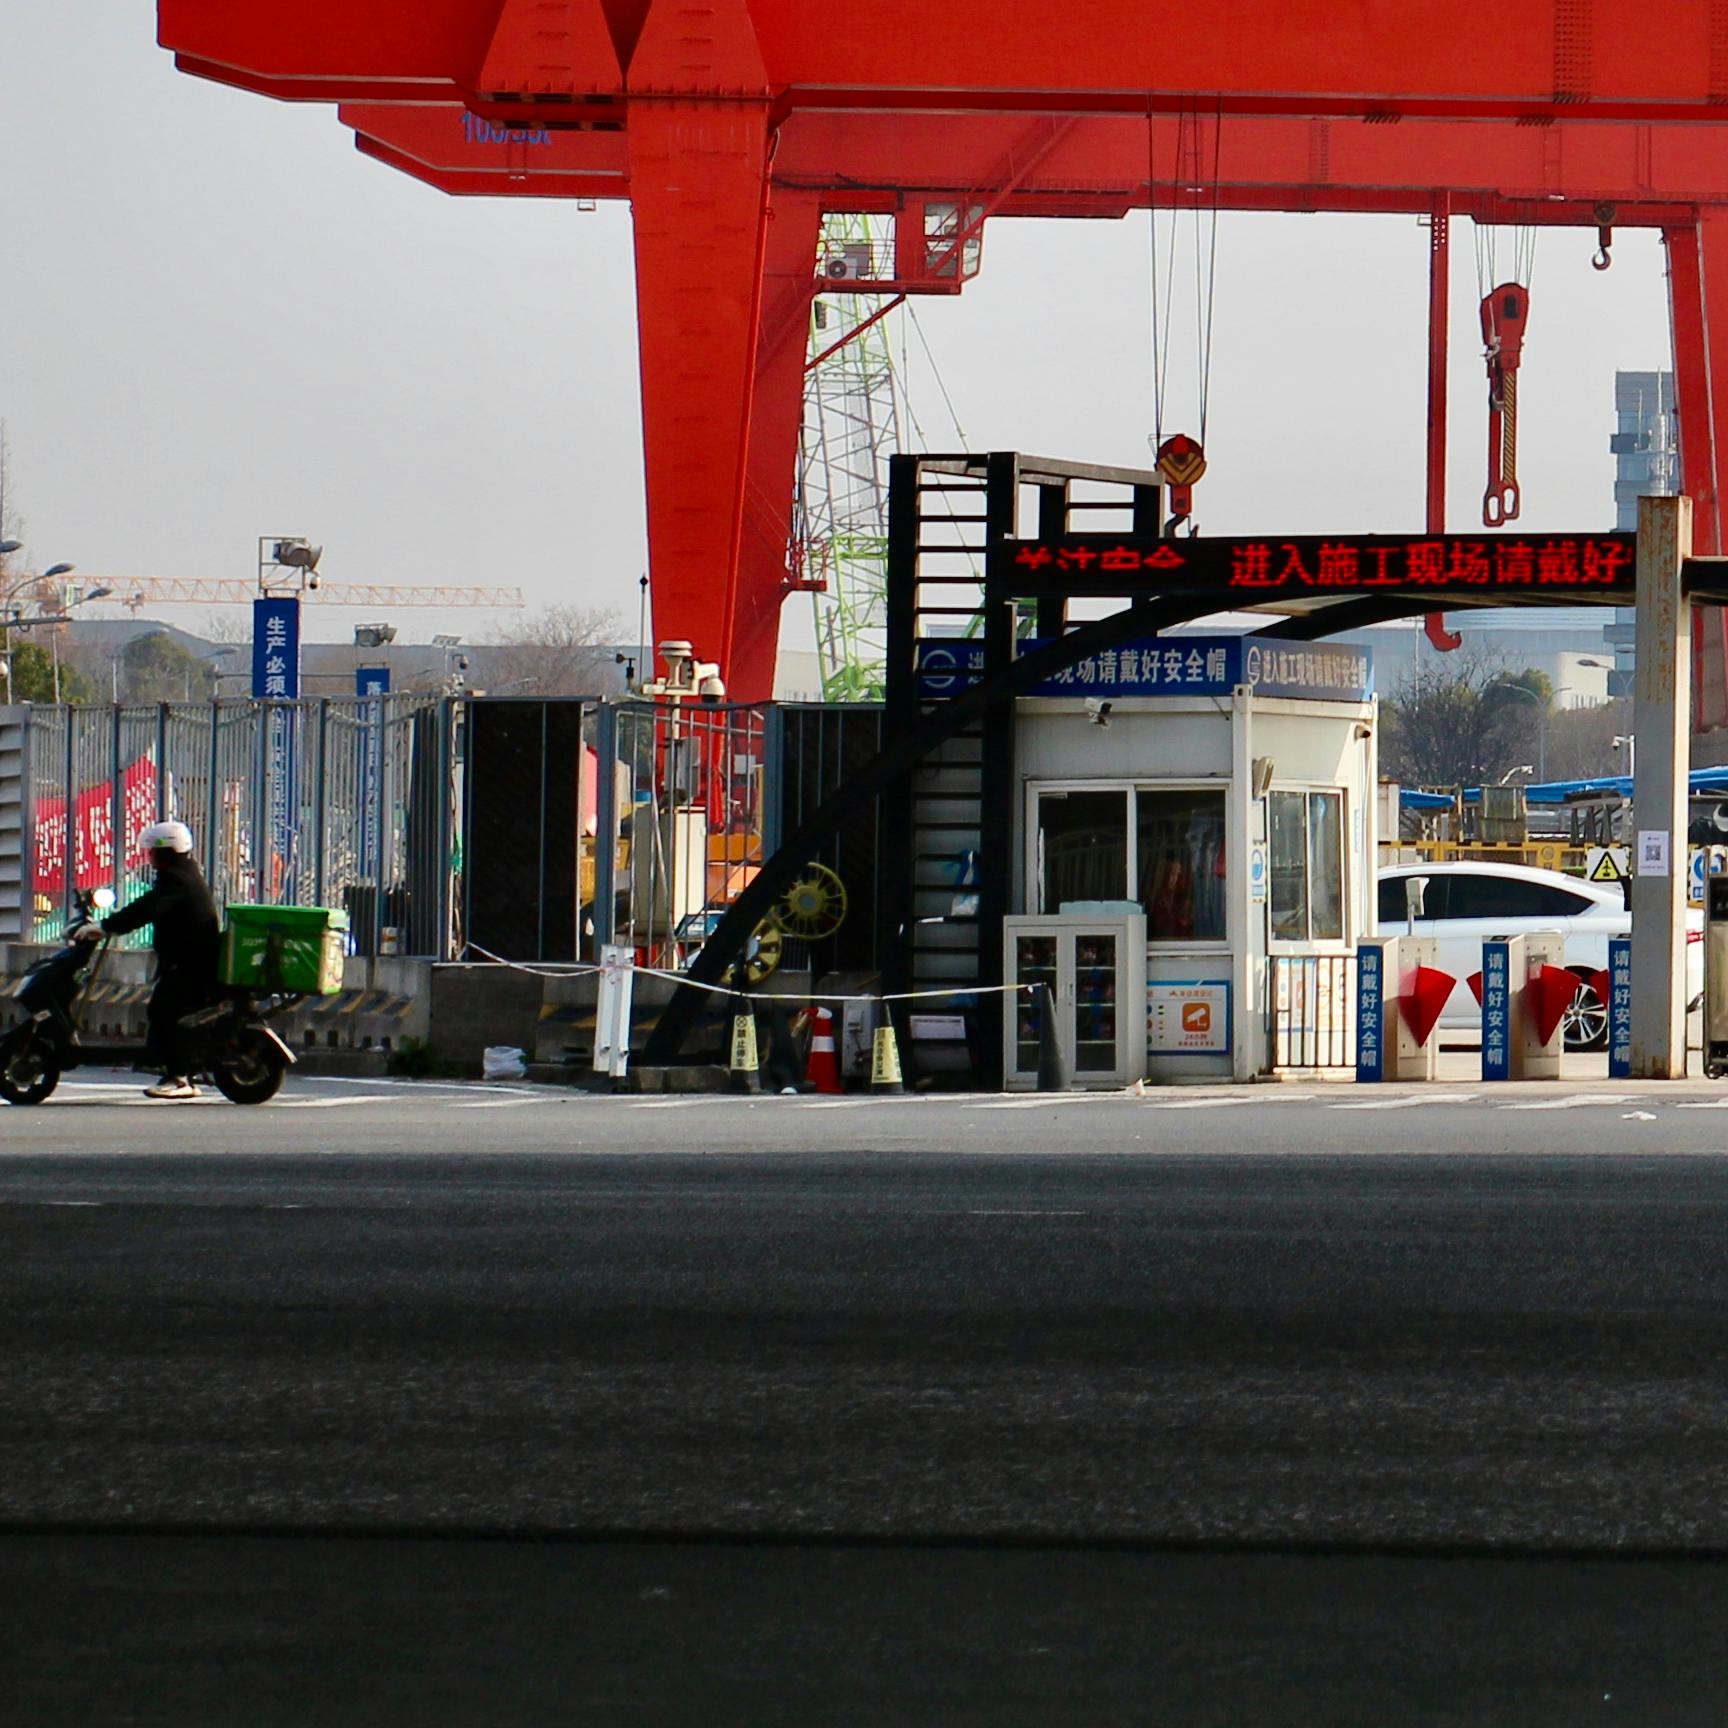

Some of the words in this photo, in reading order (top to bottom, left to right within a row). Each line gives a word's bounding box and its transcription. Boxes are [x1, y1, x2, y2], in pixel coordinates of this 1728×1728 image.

[1229, 542, 1632, 587] 进入施工现场请戴好
[1361, 955, 1378, 1067] 请戴好安全帽
[1487, 953, 1504, 1066] 请戴好安全帽
[1614, 950, 1631, 1063] 请戴好安全帽
